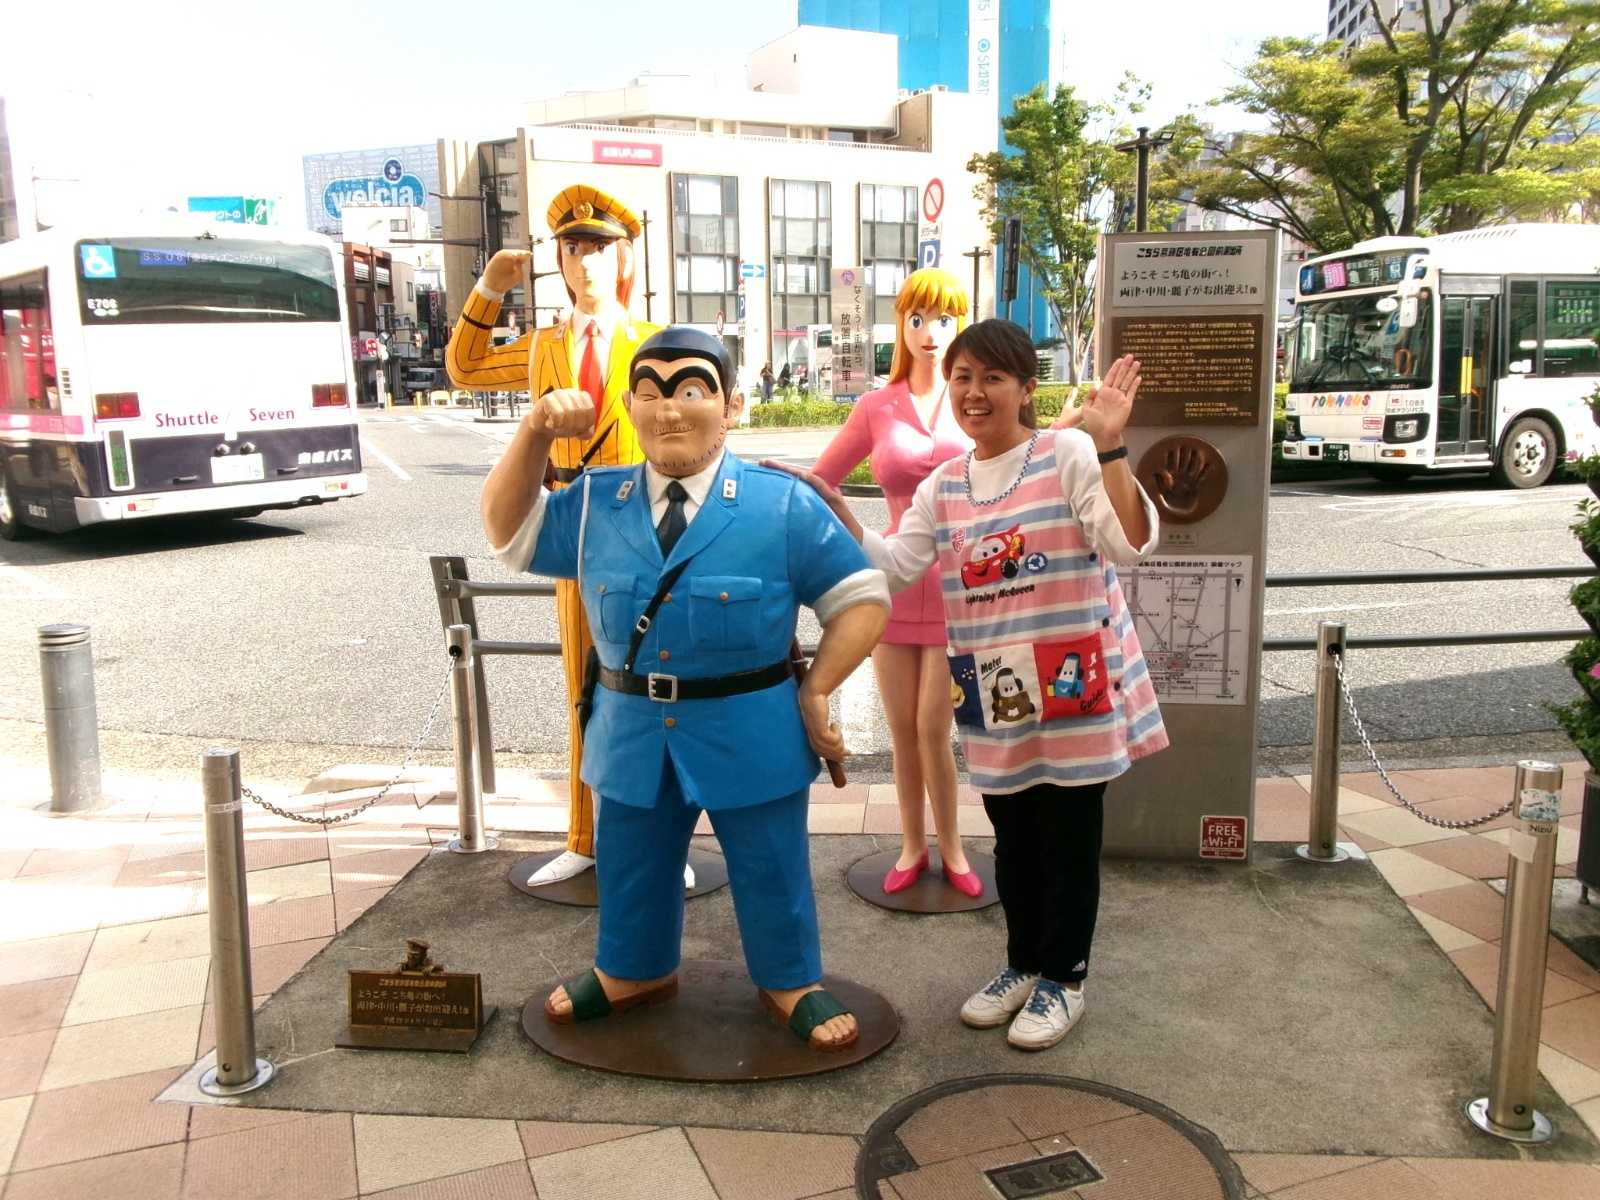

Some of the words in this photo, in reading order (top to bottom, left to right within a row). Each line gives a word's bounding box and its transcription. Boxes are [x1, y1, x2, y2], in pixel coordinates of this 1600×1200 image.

[330, 180, 414, 207] welcia
[924, 244, 937, 268] P
[1121, 269, 1158, 281] ようこそ
[155, 410, 219, 428] Shuttle
[249, 408, 295, 422] Seven
[980, 656, 1002, 675] Mater
[1208, 825, 1239, 836] FREE
[1208, 836, 1238, 848] Wi-Fi
